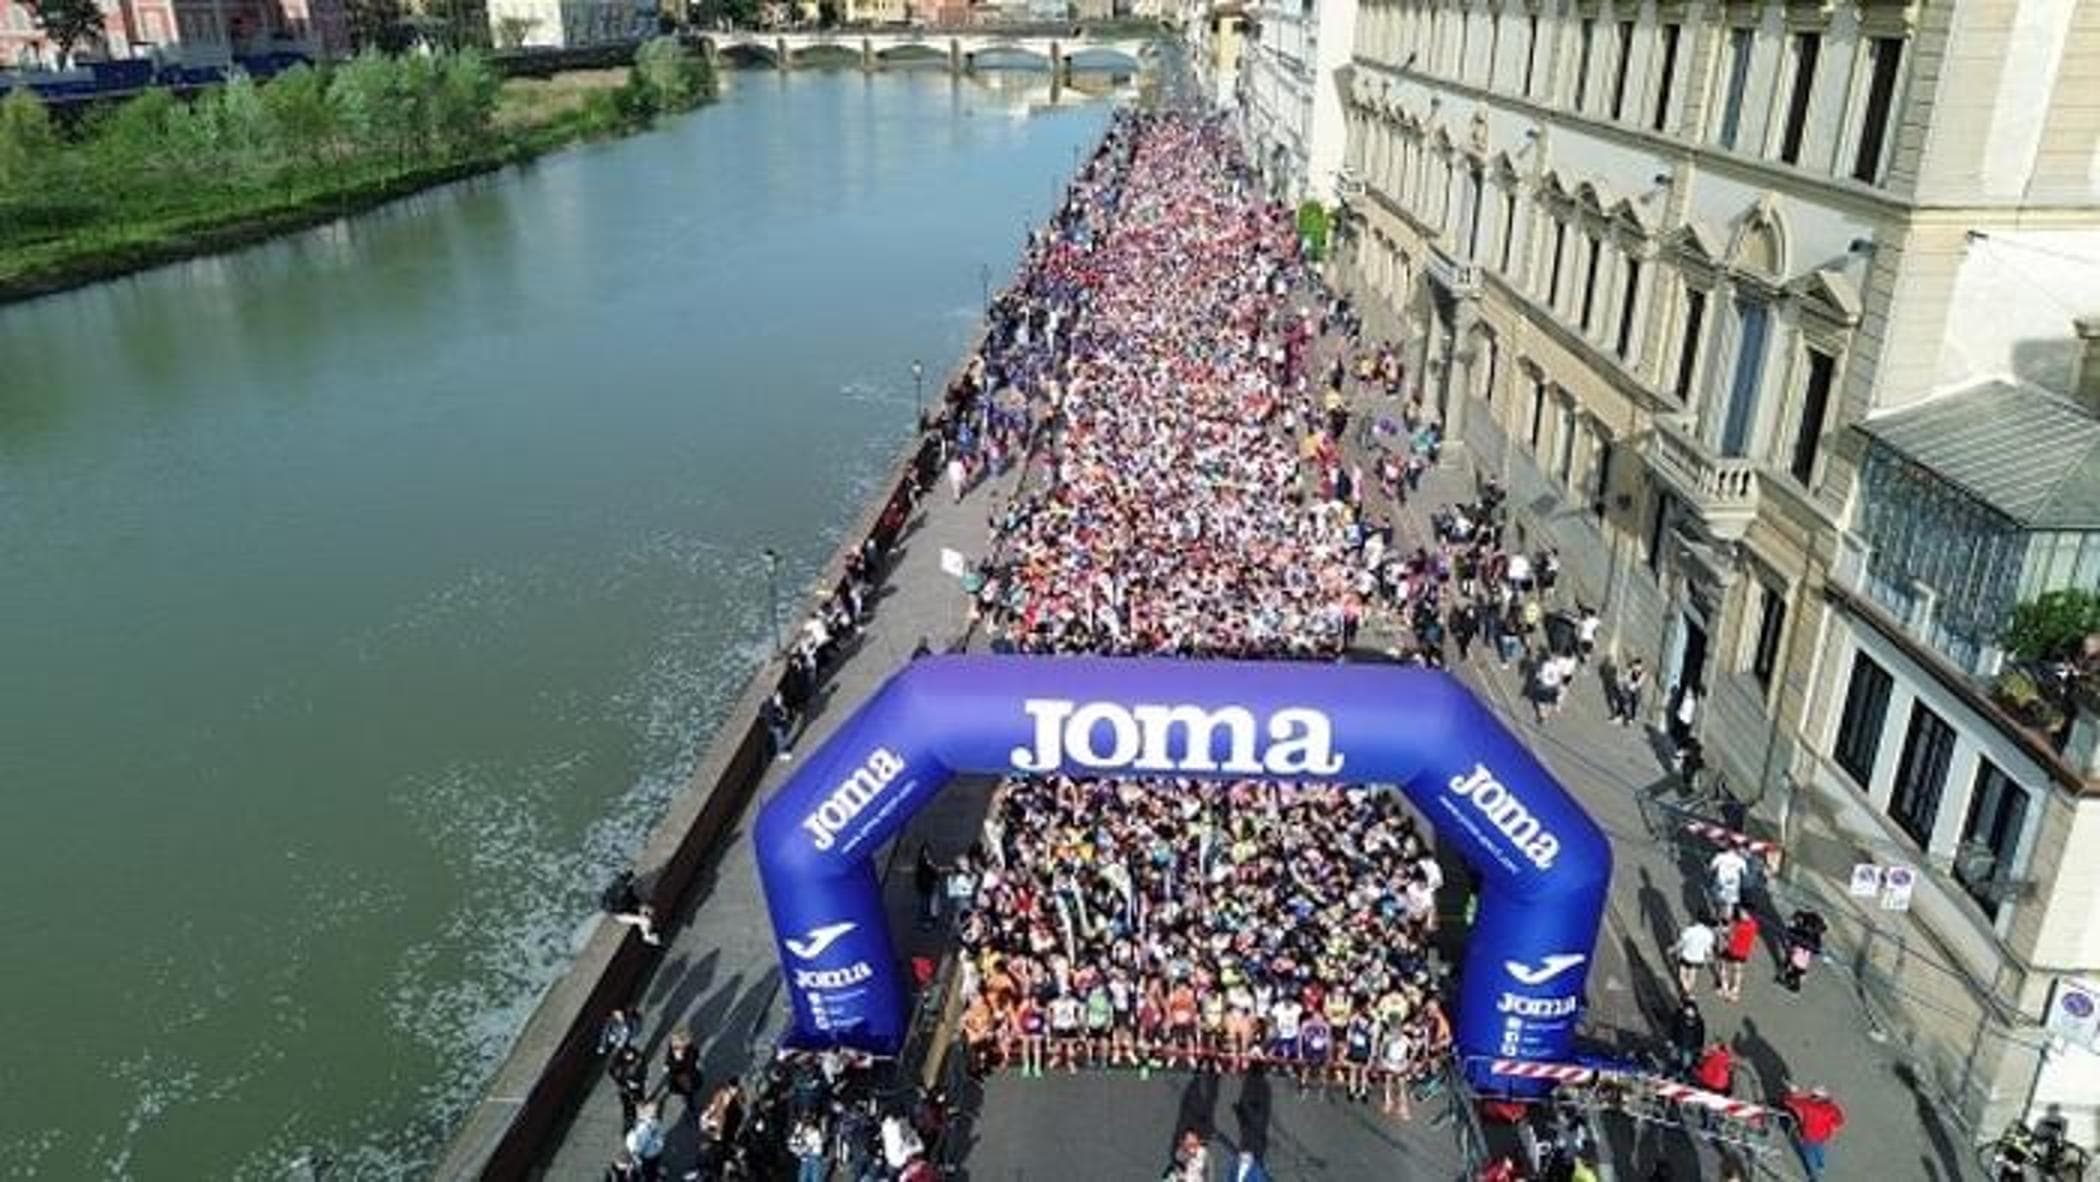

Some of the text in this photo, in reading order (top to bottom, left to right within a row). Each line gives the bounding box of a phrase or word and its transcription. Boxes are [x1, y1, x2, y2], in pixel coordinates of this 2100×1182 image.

[1010, 699, 1344, 773] Joma
[803, 748, 904, 850] Joma
[1450, 763, 1560, 869] Joma
